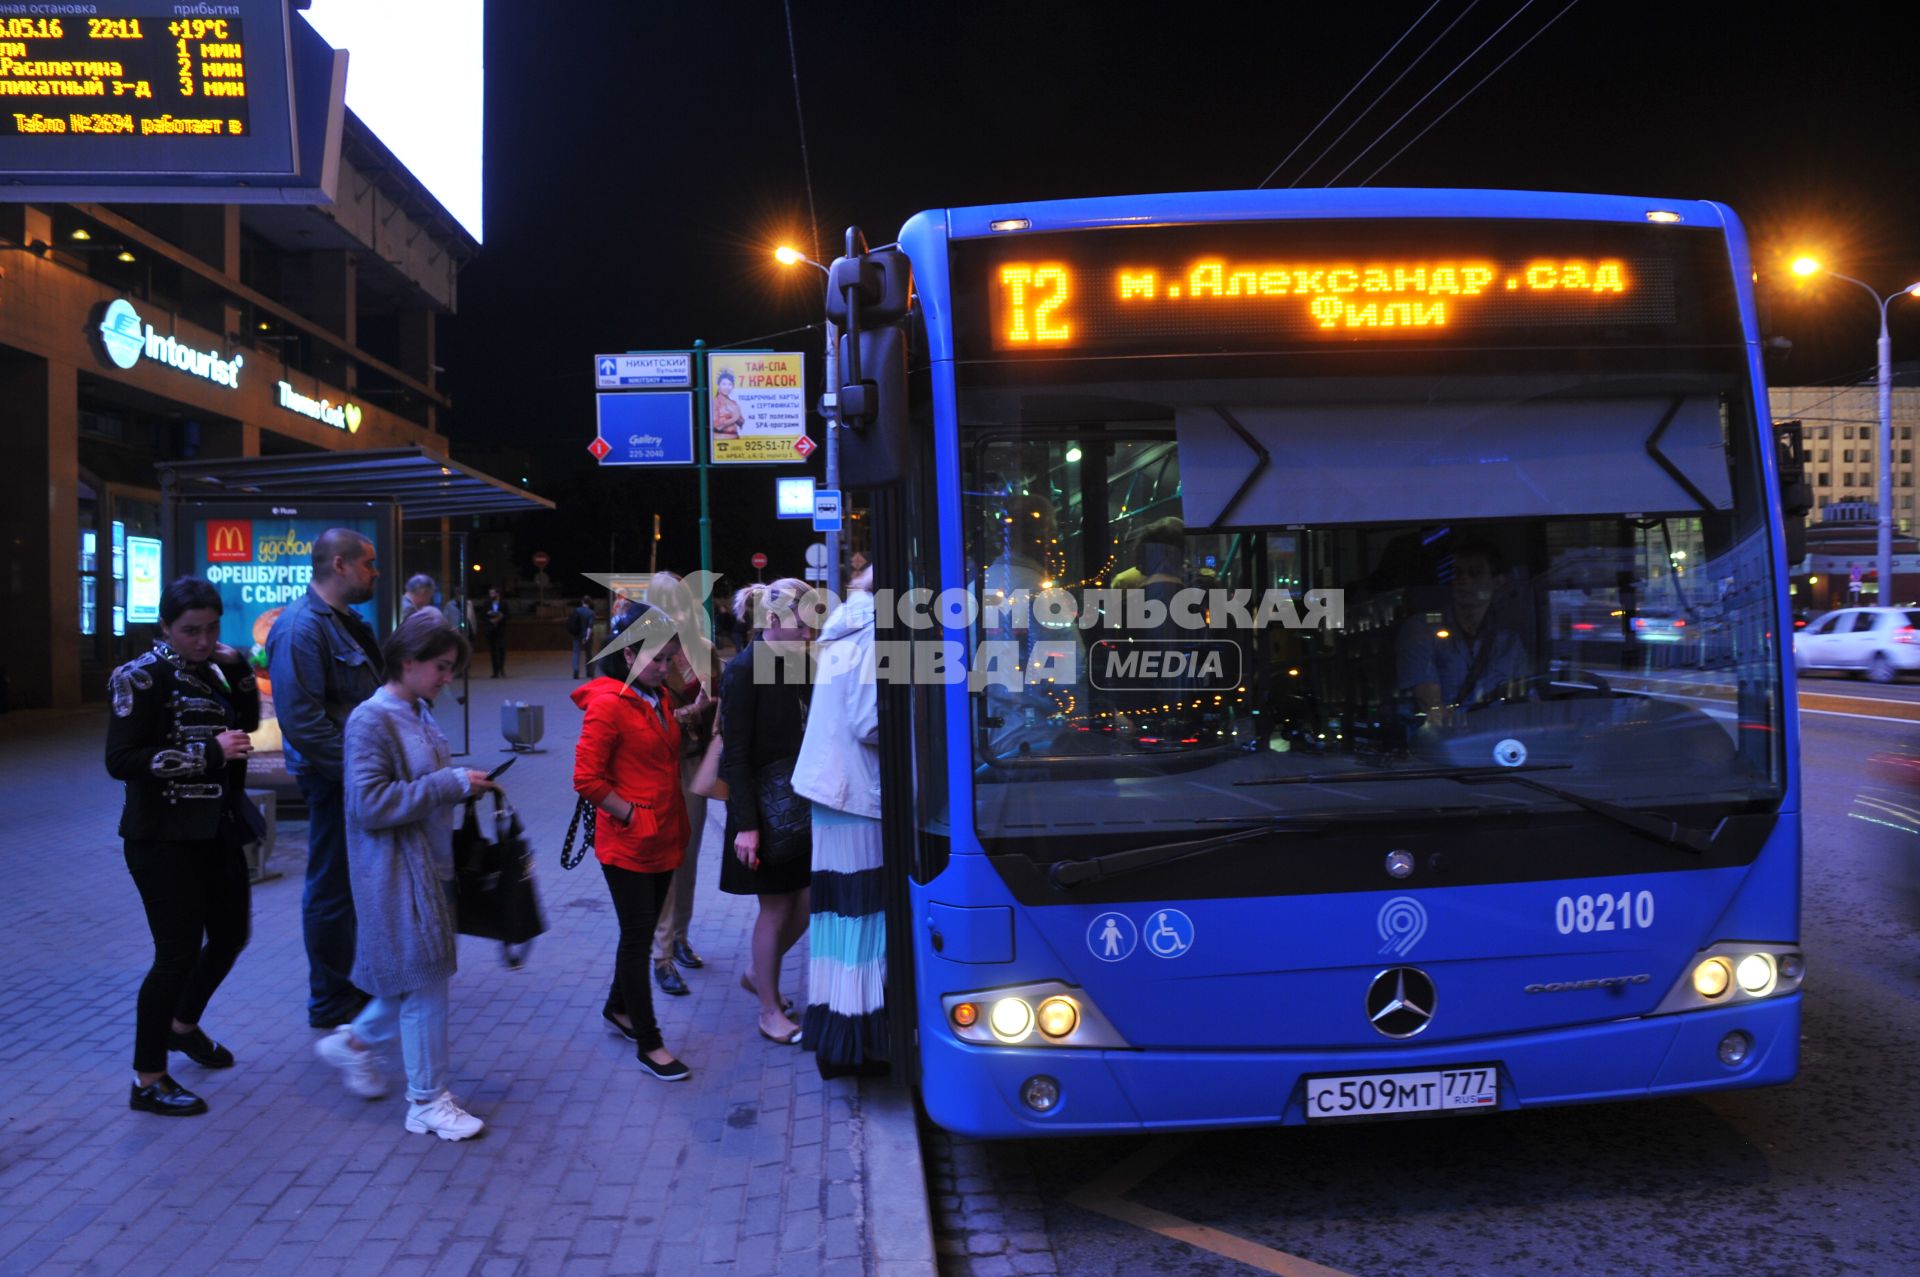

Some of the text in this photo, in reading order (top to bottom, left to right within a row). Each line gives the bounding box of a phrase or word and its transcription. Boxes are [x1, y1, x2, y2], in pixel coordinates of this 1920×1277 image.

[29, 4, 97, 14] остановка
[173, 2, 240, 17] прибытия
[87, 18, 143, 38] 22:11
[176, 38, 191, 57] 1
[200, 43, 242, 58] мин
[178, 57, 192, 77] 2
[201, 62, 244, 77] мин
[112, 80, 152, 98] з-д
[179, 76, 194, 96] 3
[203, 81, 245, 97] мин
[13, 113, 66, 133] Табло
[140, 114, 223, 135] работает
[228, 118, 243, 134] в
[1308, 294, 1447, 329] Фили
[144, 323, 240, 389] Intourist
[625, 356, 686, 368] НИКИТСКИЙ
[744, 360, 788, 373] ТАЙ-СПА
[738, 374, 797, 387] 7 КРАСОК
[628, 434, 663, 448] Gallery
[744, 440, 792, 451] 925-51-77
[241, 585, 254, 603] С
[1555, 890, 1655, 935] 08210
[1444, 1070, 1488, 1096] 777
[1454, 1095, 1477, 1105] RUS
